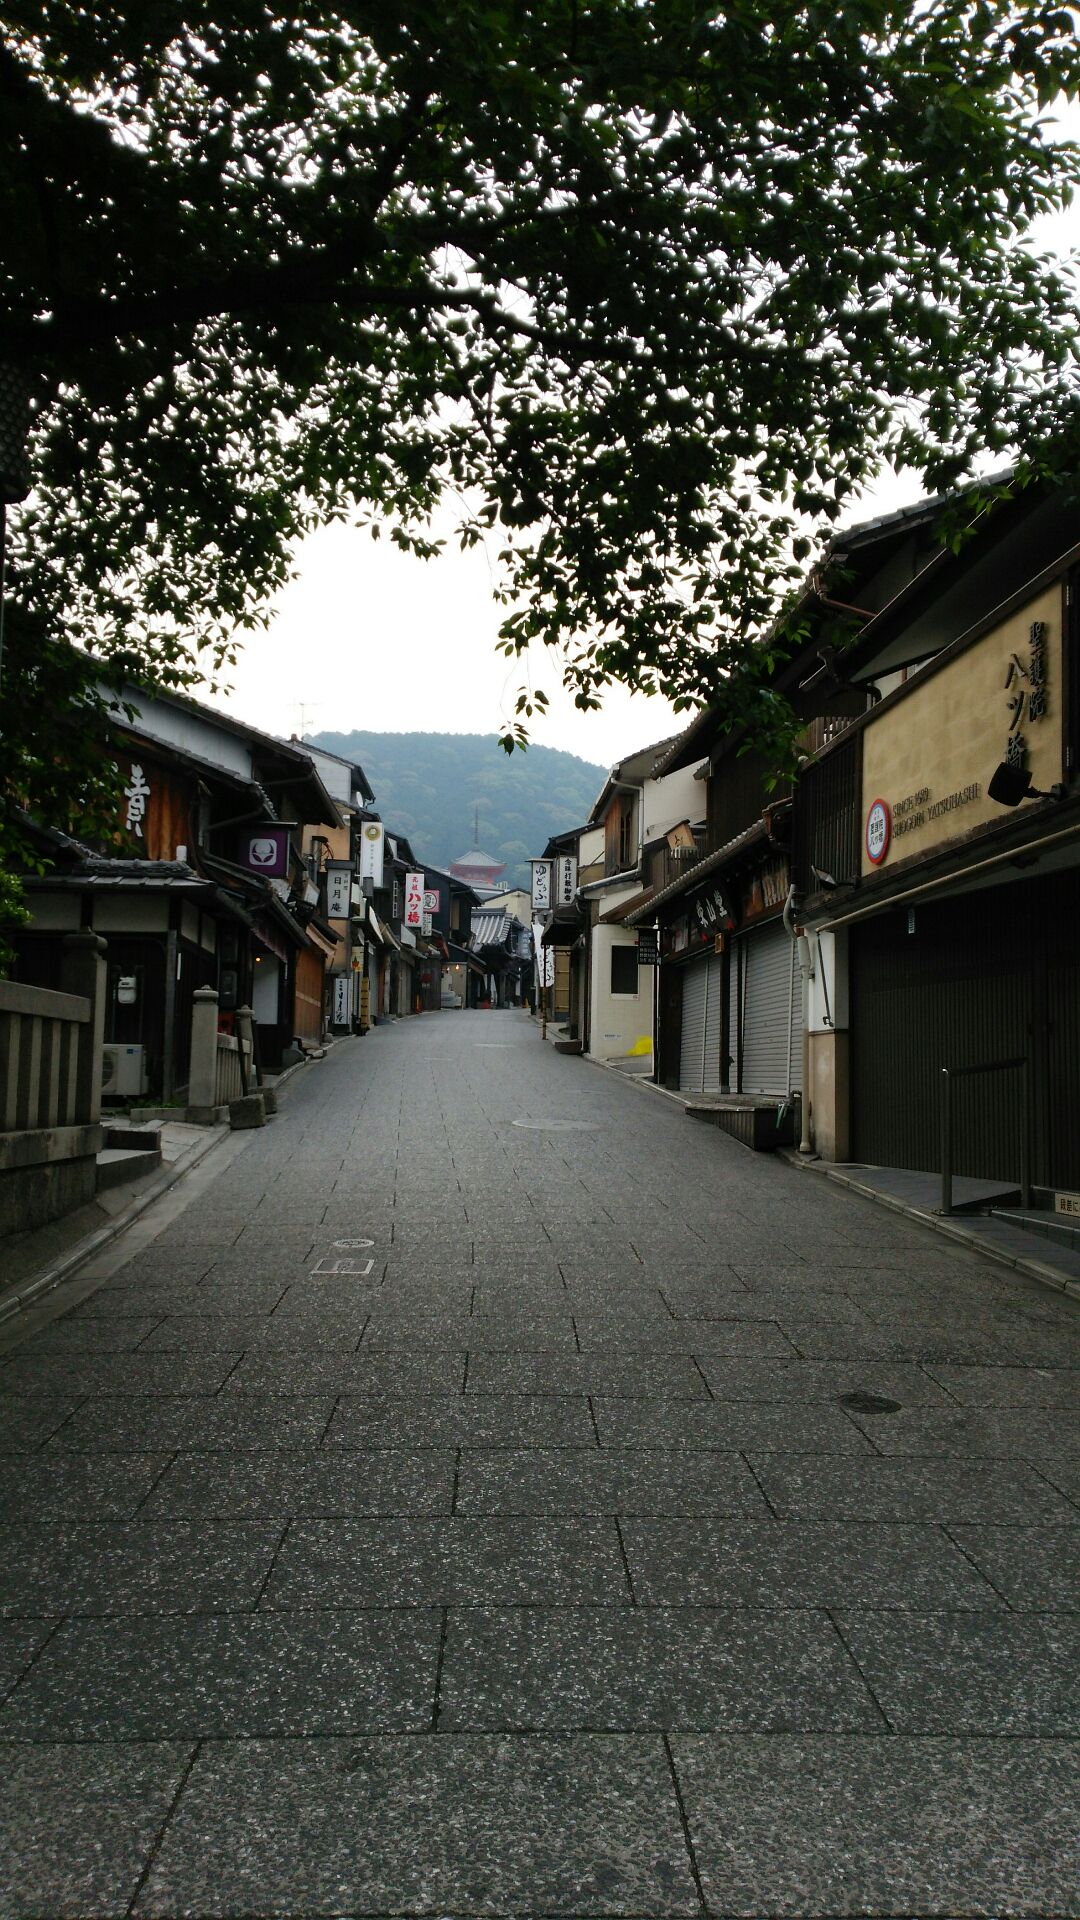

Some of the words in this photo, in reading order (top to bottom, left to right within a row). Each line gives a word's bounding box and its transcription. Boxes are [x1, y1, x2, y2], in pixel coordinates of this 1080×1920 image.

[1028, 621, 1045, 722] 聖護院
[892, 796, 914, 819] SINCE
[914, 787, 929, 806] 1689
[892, 811, 925, 839] SHOGOIN
[927, 782, 980, 821] YATSUHASHI
